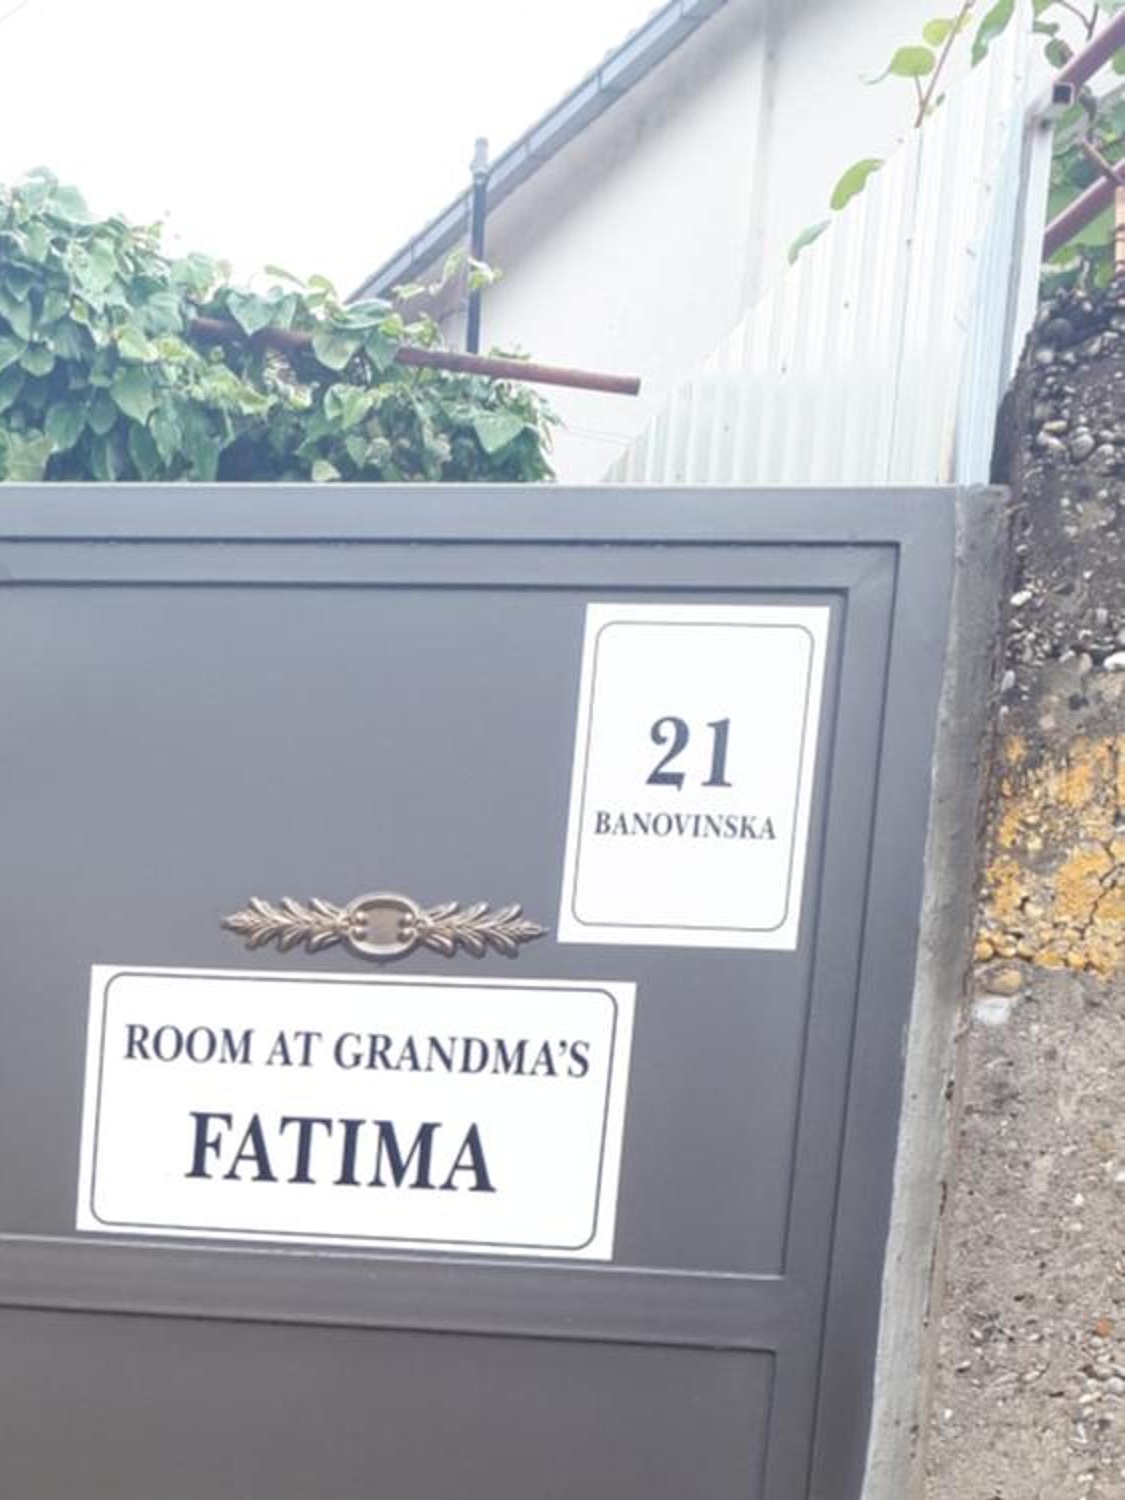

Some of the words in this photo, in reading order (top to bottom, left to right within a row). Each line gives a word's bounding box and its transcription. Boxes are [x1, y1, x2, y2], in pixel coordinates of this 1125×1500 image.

[644, 716, 732, 792] 21
[593, 811, 776, 841] BANOVINSKA
[124, 1024, 256, 1065] ROOM
[266, 1030, 322, 1067] AT
[333, 1033, 592, 1078] GRANDMA'S
[184, 1111, 497, 1193] FATIMA
